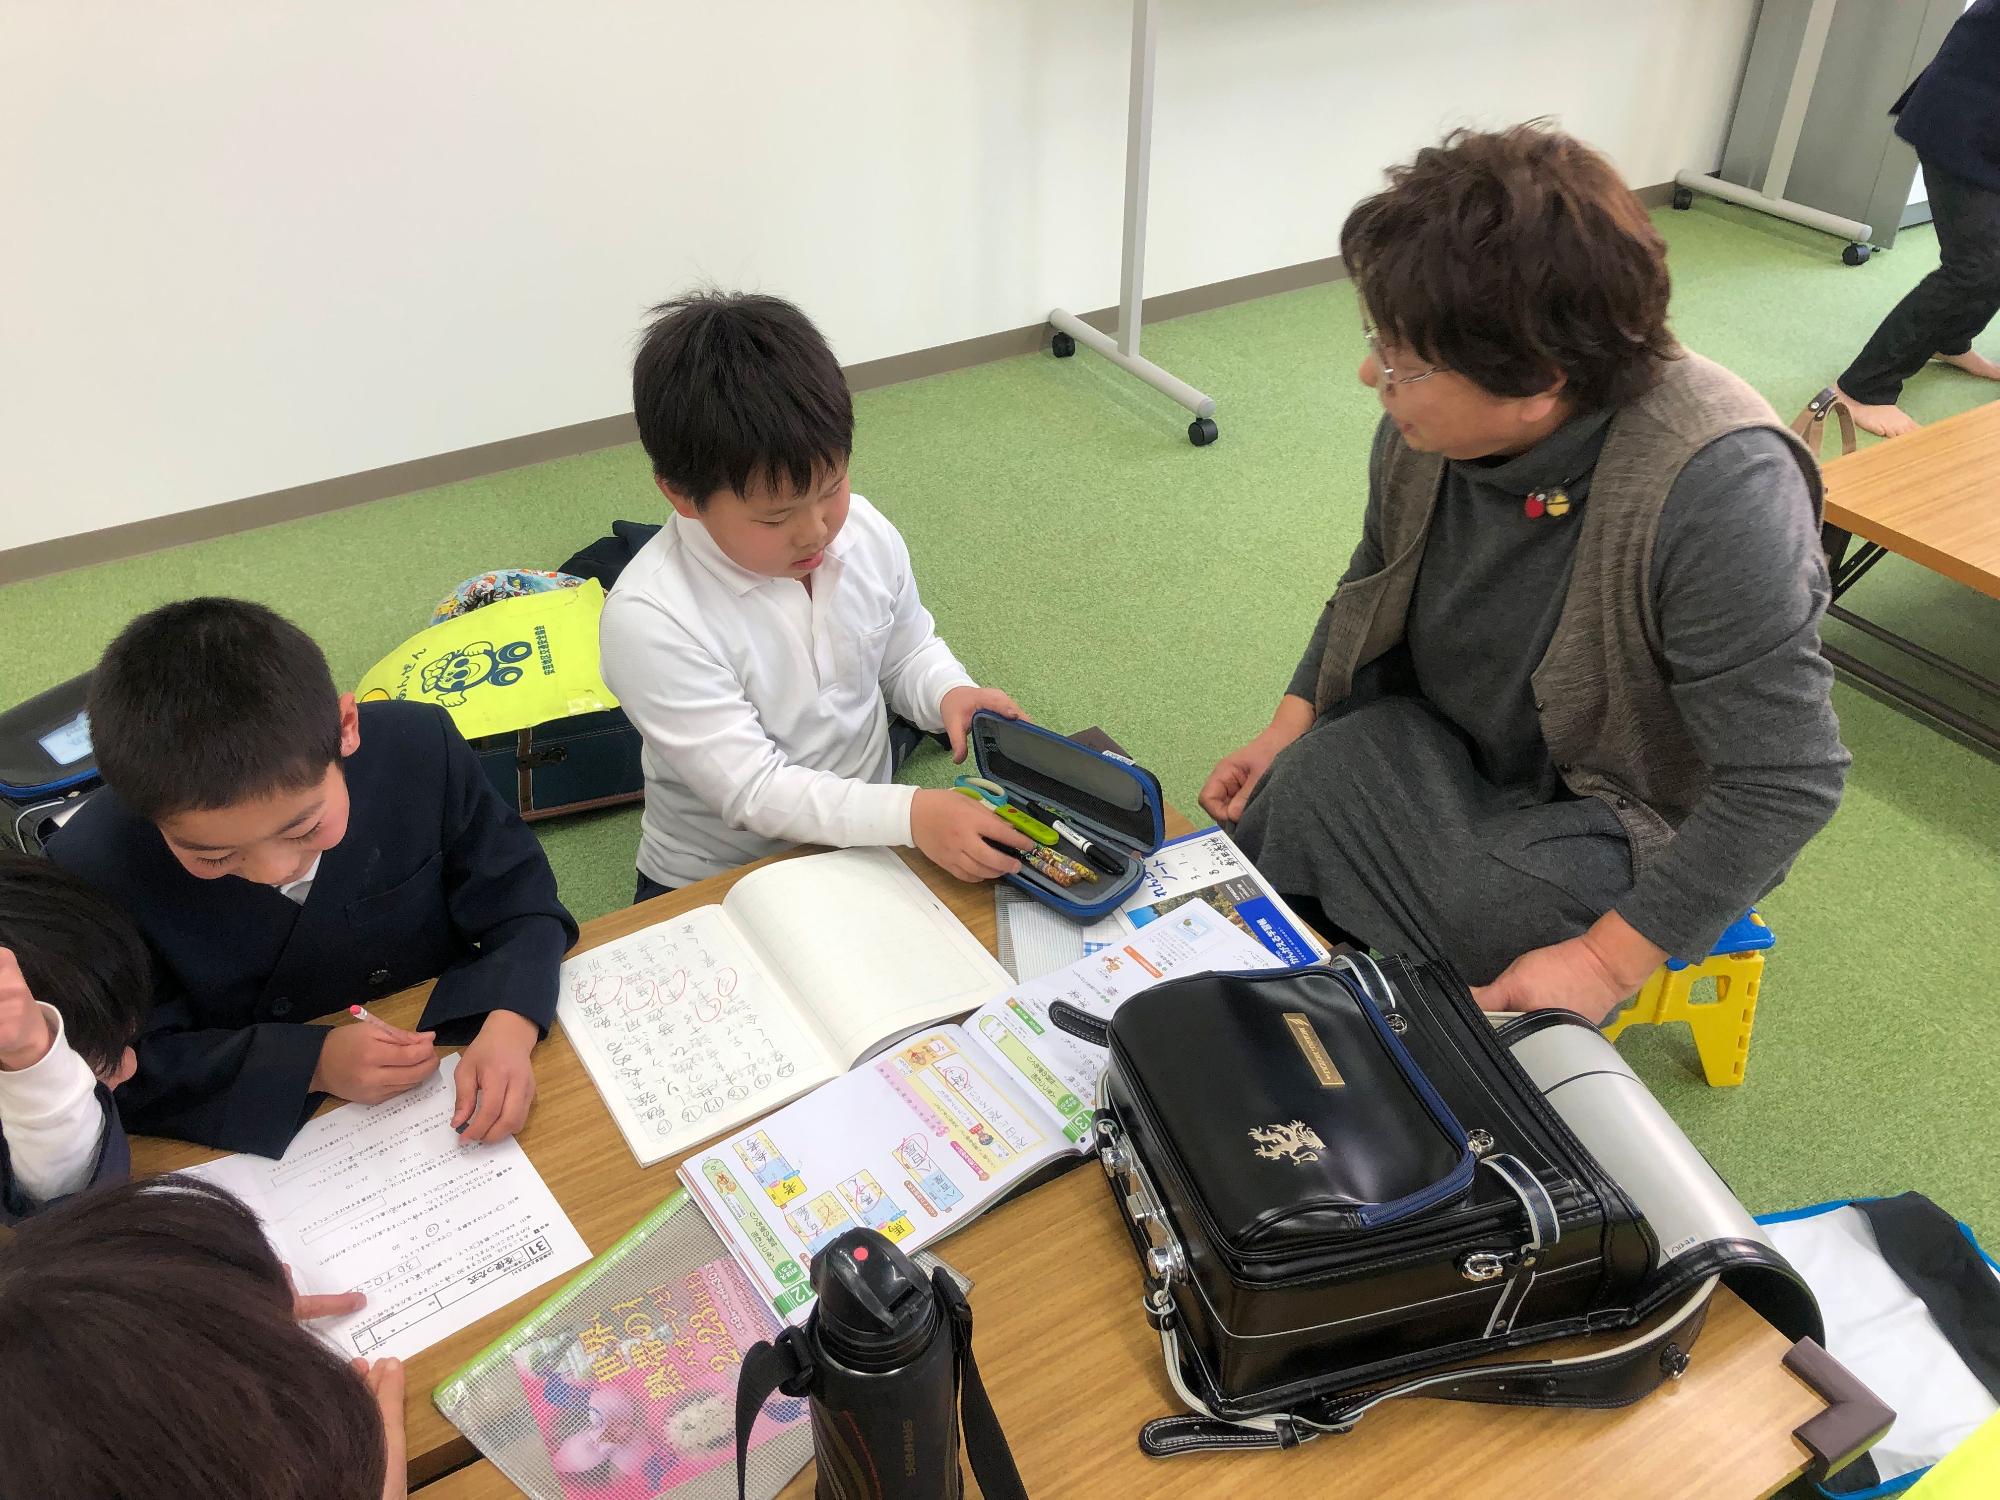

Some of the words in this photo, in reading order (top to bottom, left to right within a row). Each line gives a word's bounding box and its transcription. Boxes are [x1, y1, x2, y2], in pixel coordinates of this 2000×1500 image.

[1255, 916, 1299, 965] かんがえる学習帳
[1072, 1111, 1093, 1131] 13
[779, 1178, 798, 1197] 考
[886, 1220, 905, 1238] 馬
[527, 1239, 546, 1255] 31
[789, 1281, 813, 1303] 12
[903, 1419, 915, 1477] SAHARA
